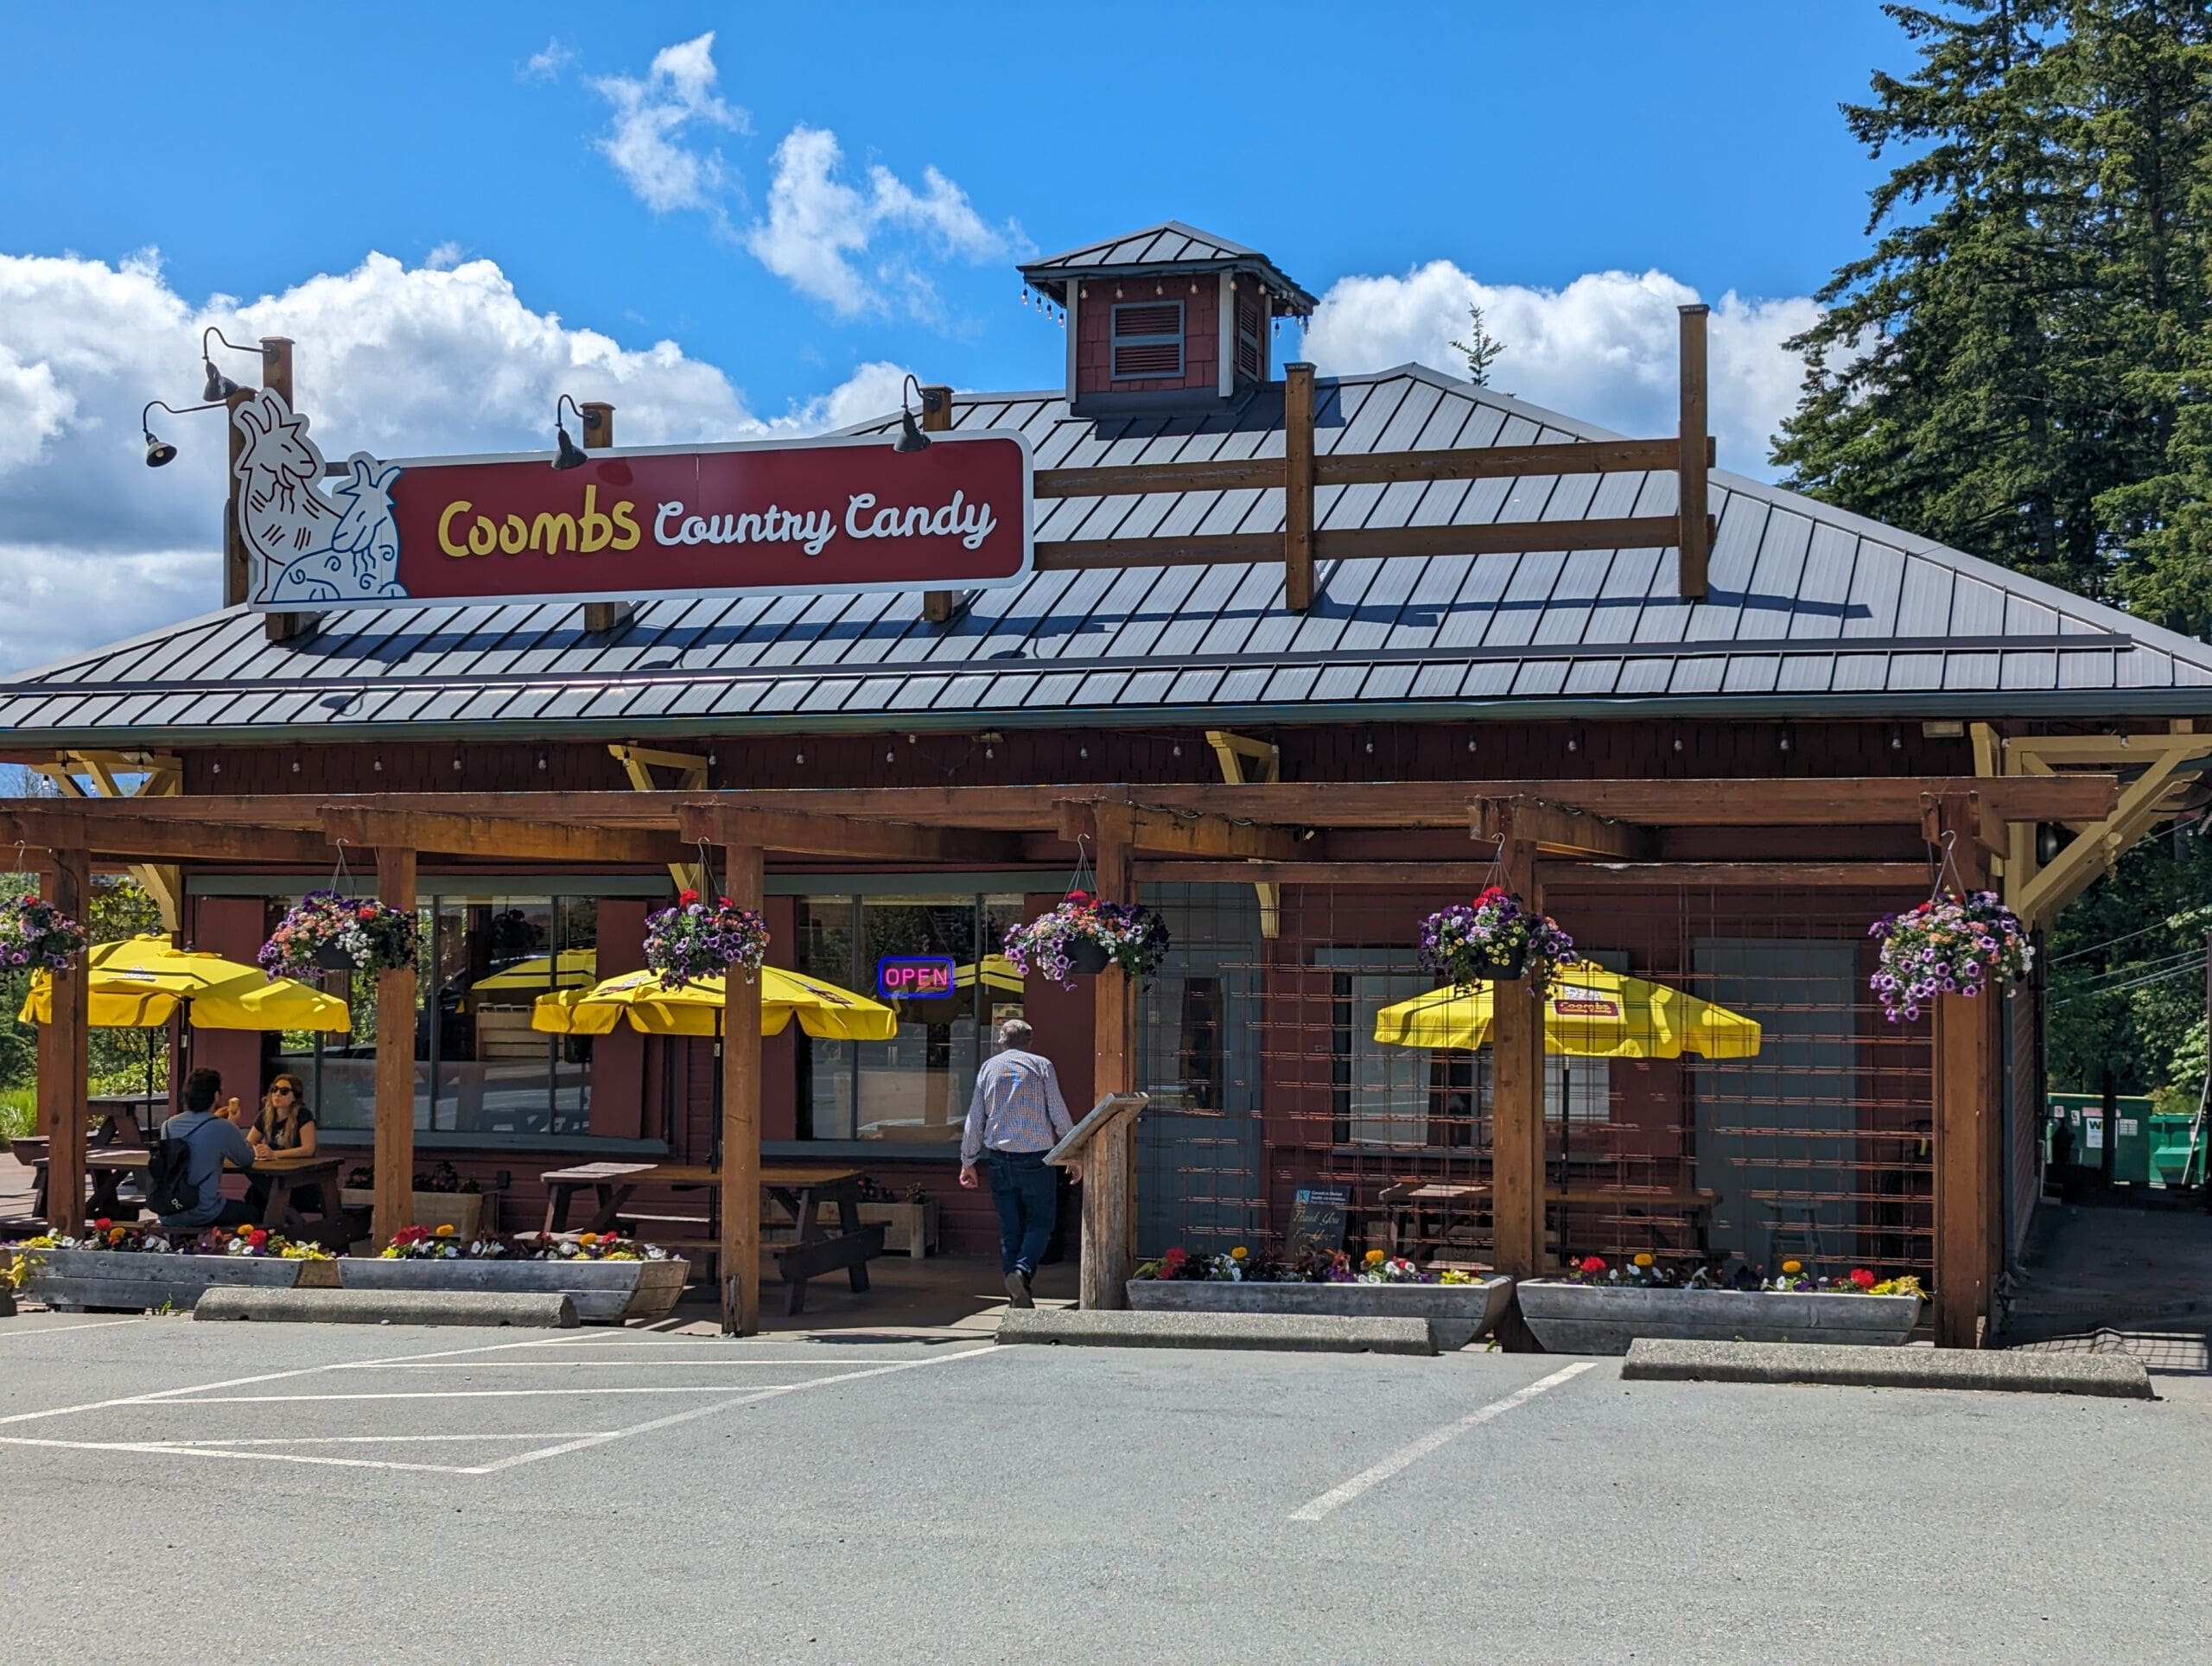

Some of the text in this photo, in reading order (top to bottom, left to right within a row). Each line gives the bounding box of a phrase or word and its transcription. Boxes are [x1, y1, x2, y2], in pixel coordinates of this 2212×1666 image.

[438, 484, 997, 557] Coombs Country Candy
[885, 968, 948, 987] OPEN
